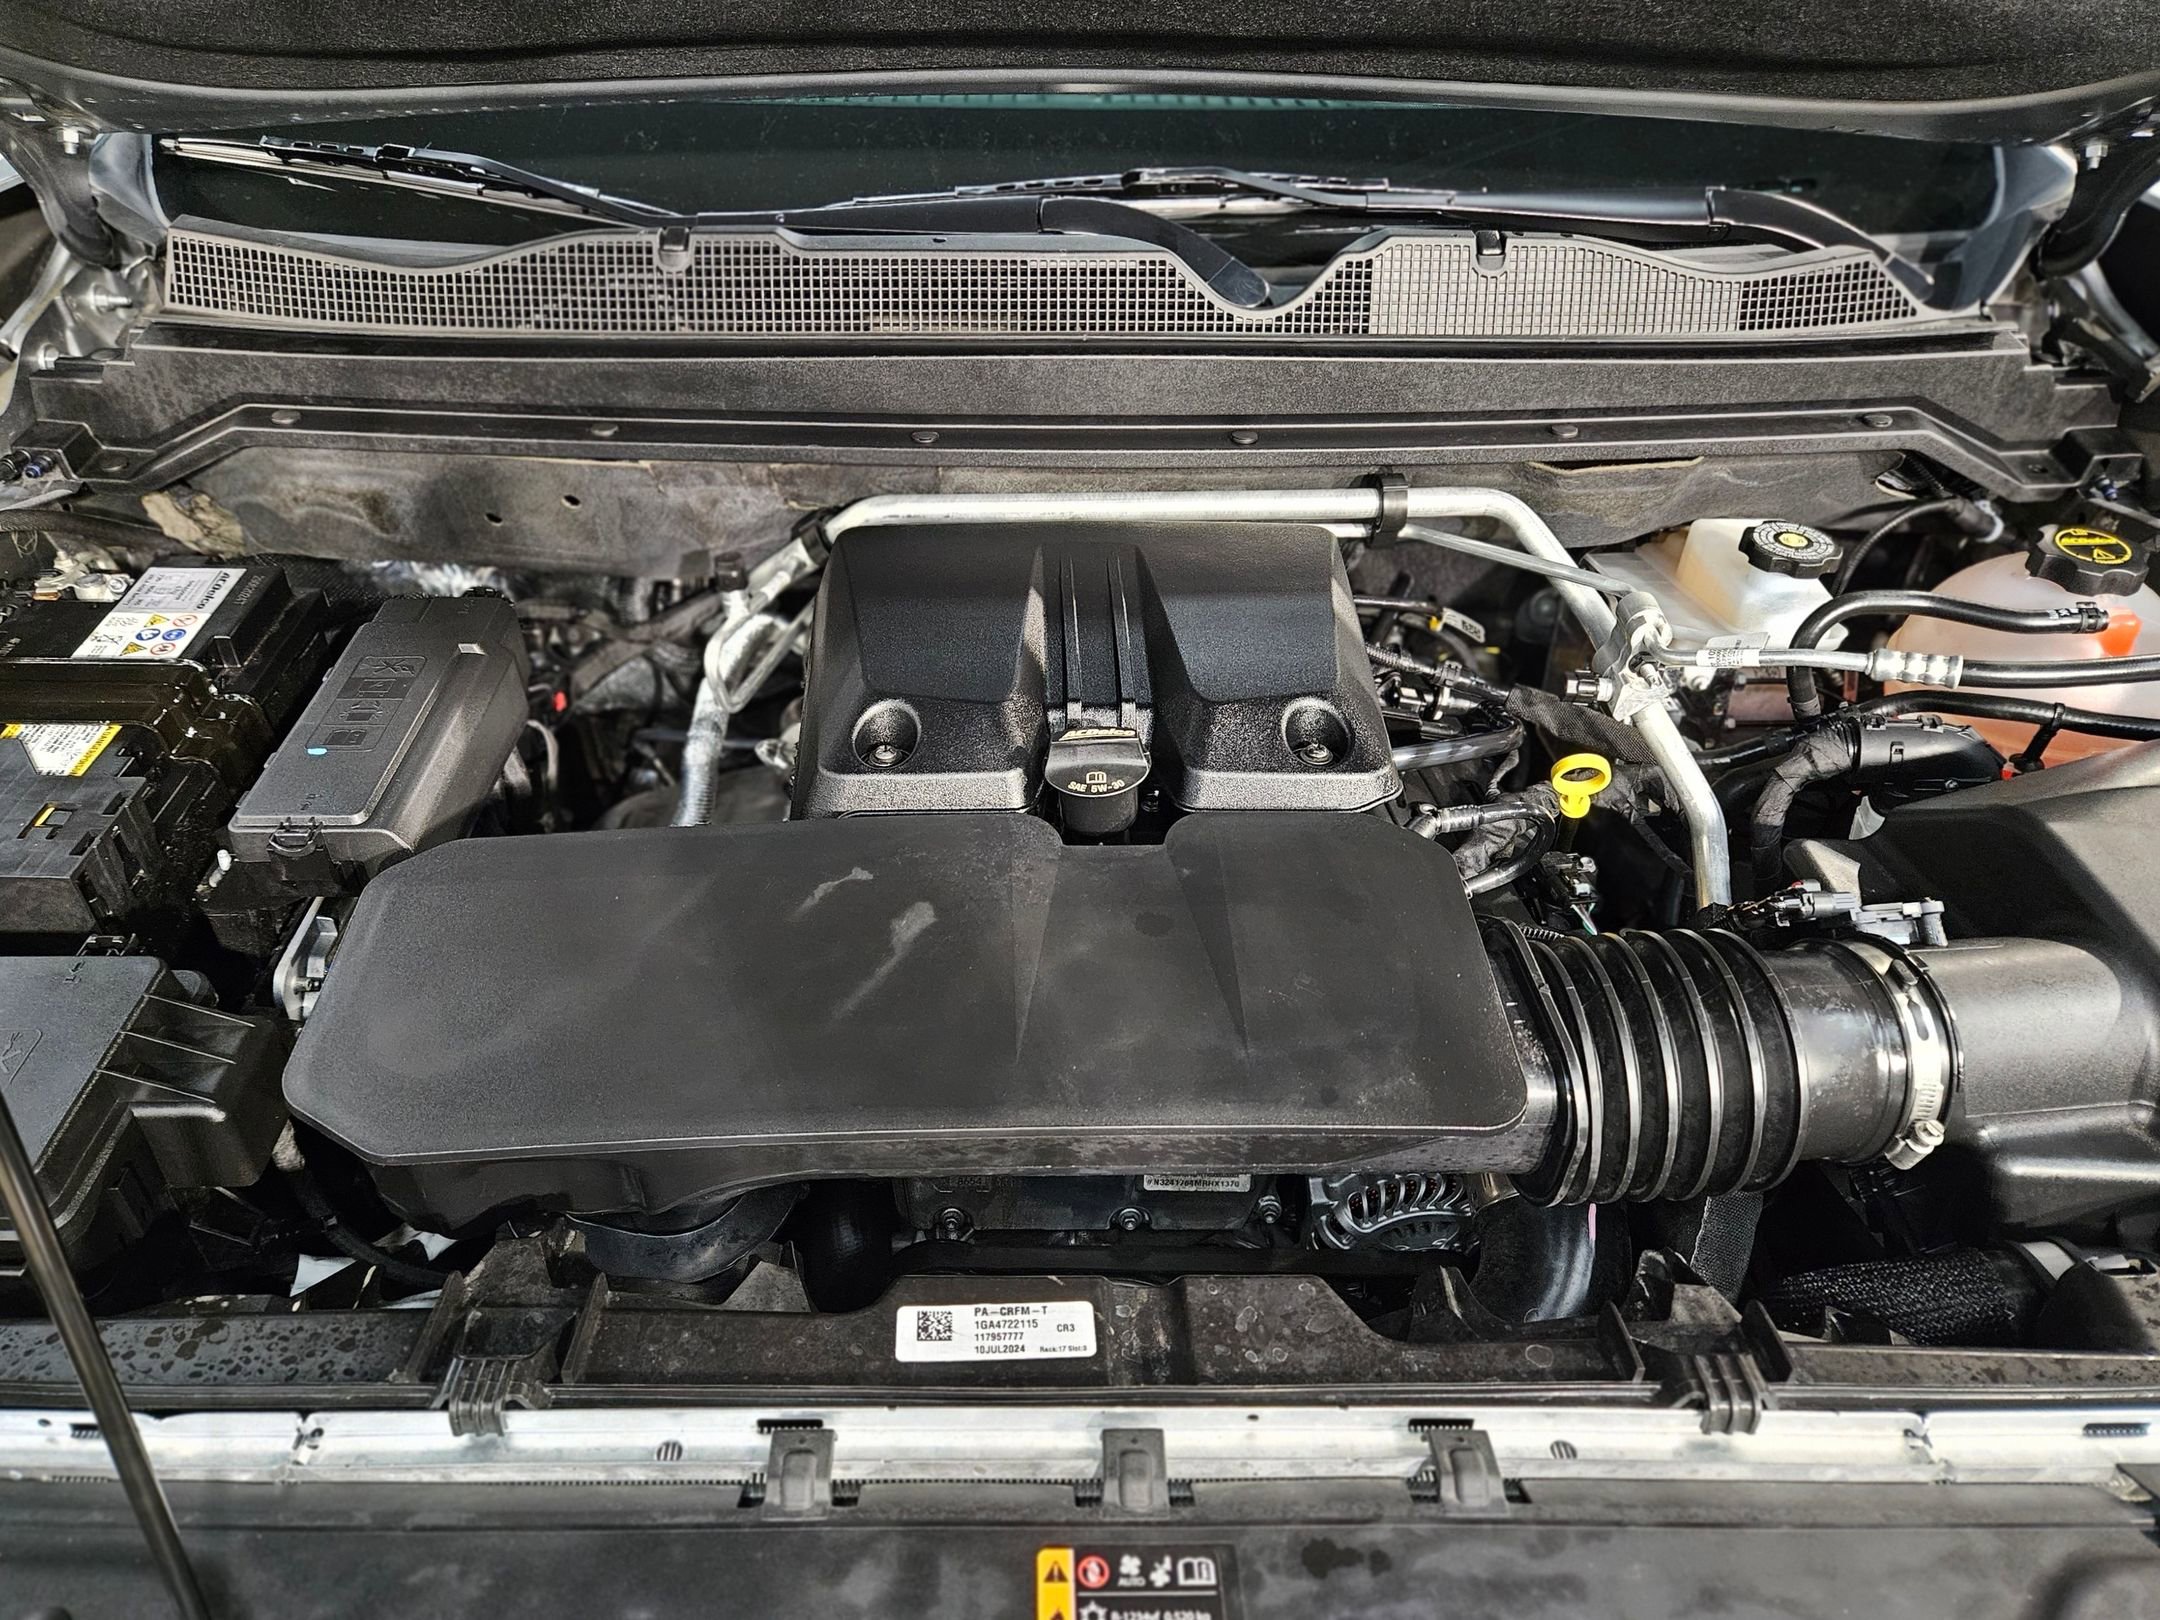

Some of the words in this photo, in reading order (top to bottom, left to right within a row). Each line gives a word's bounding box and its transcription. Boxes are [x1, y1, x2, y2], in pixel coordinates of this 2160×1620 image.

[196, 572, 230, 609] ACDelco
[1068, 781, 1087, 792] SAE
[1091, 779, 1125, 793] 5W-30
[974, 1306, 1048, 1316] PA-CRFM-T
[975, 1319, 1039, 1329] 1GA4722115
[1056, 1323, 1075, 1332] CR3
[975, 1332, 1024, 1341] 117957777
[975, 1345, 1025, 1354] 10JUL2024
[1118, 1576, 1146, 1587] AUTO
